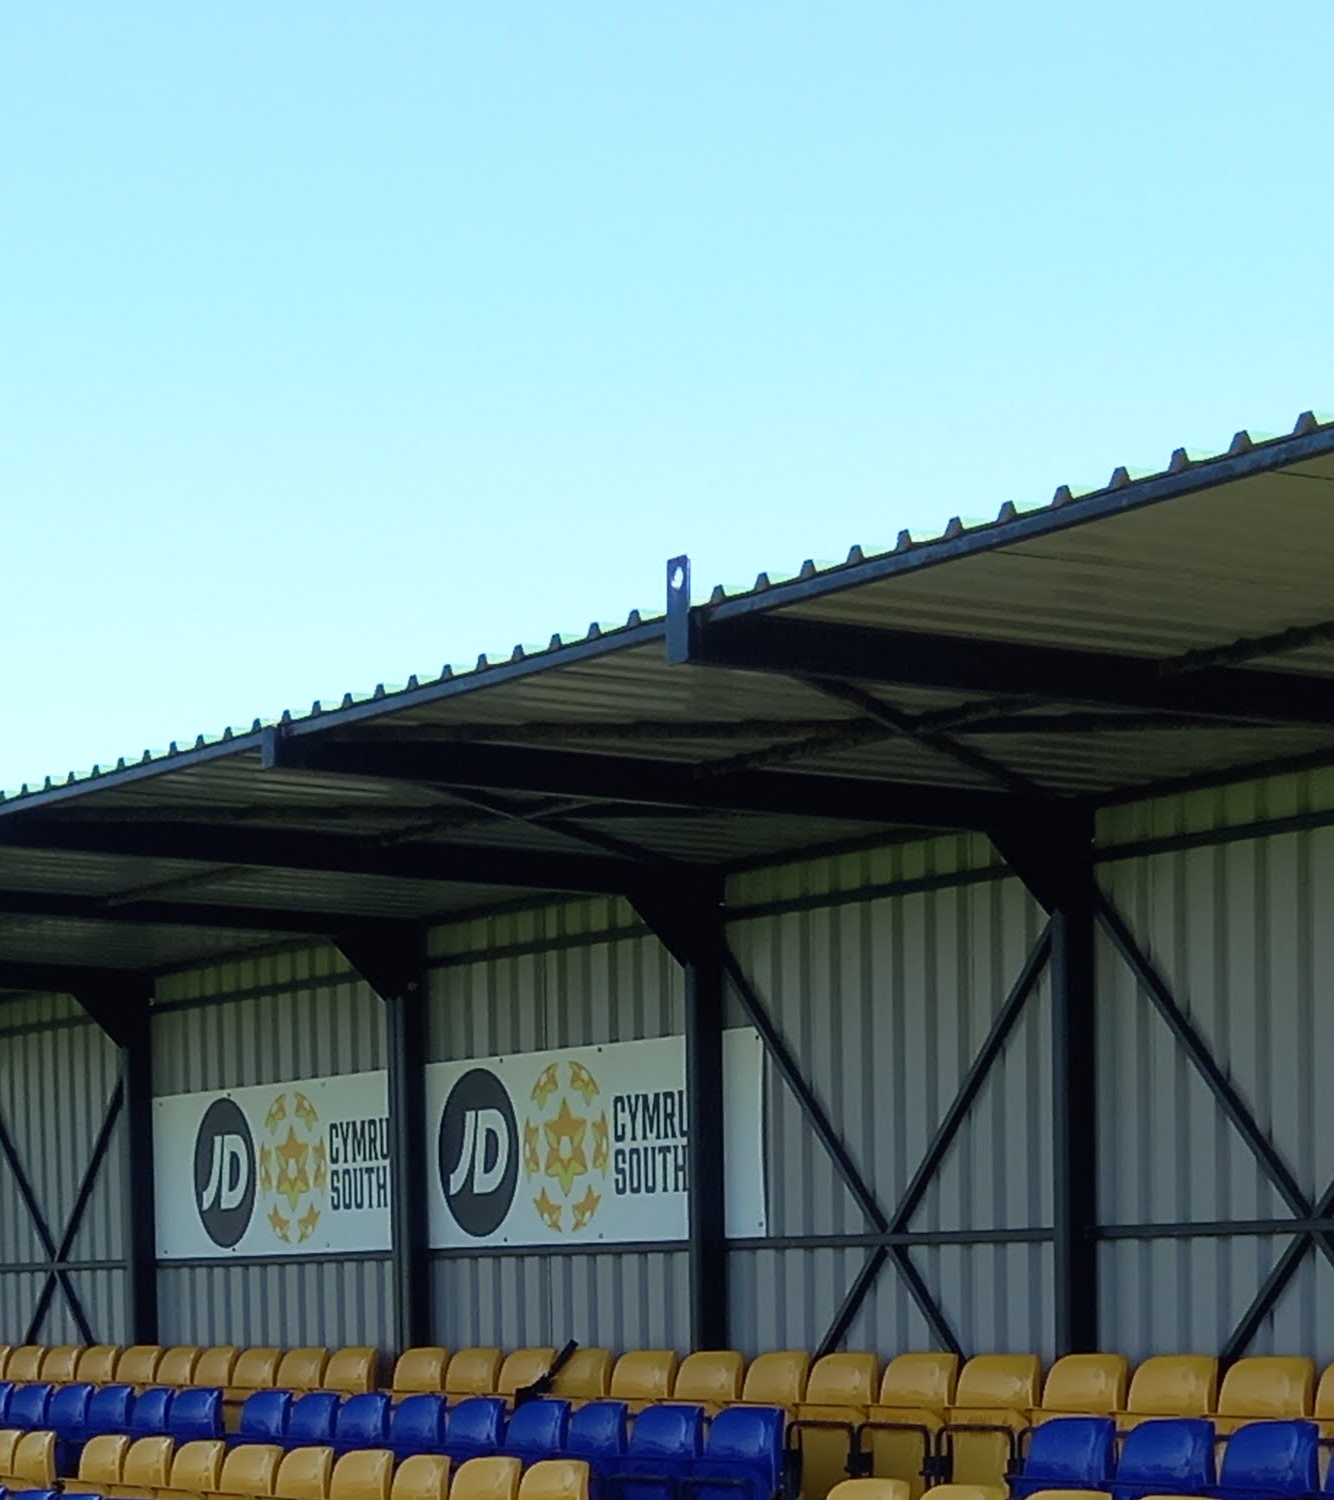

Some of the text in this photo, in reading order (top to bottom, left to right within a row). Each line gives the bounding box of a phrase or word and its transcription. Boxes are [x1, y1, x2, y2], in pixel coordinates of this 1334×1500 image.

[329, 1117, 389, 1165] CYMRU
[613, 1090, 688, 1142] CYMRU
[202, 1134, 249, 1211] JD
[449, 1108, 509, 1196] JD
[614, 1144, 689, 1195] SOUTH
[331, 1165, 388, 1211] SOUTH
